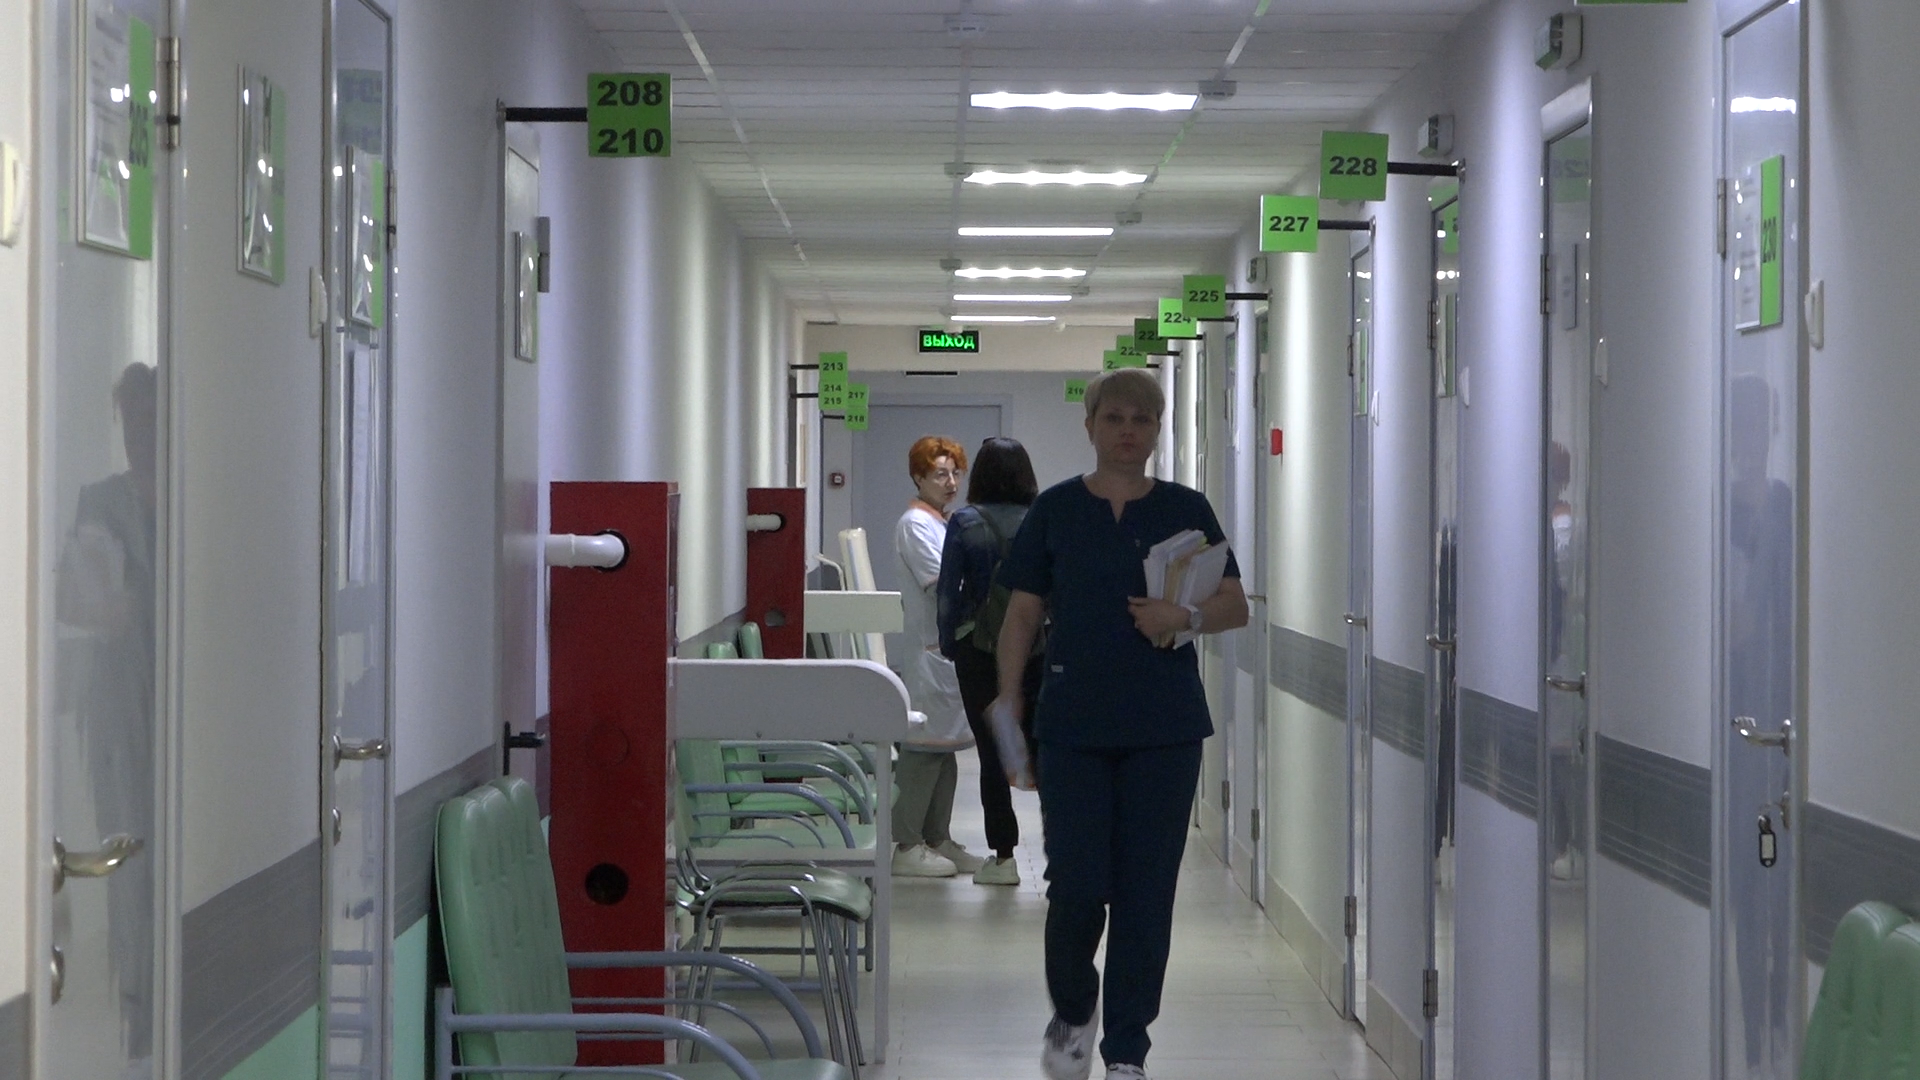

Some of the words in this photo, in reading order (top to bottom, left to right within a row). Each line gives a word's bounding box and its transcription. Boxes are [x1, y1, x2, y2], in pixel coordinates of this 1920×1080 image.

[598, 80, 663, 106] 208
[597, 128, 664, 154] 210
[1329, 155, 1378, 177] 228
[1269, 216, 1310, 232] 227
[1188, 289, 1219, 303] 225
[923, 335, 975, 349] ВЫХОД
[822, 362, 844, 371] 213
[823, 384, 842, 392] 214
[847, 391, 865, 399] 217
[823, 397, 842, 405] 215
